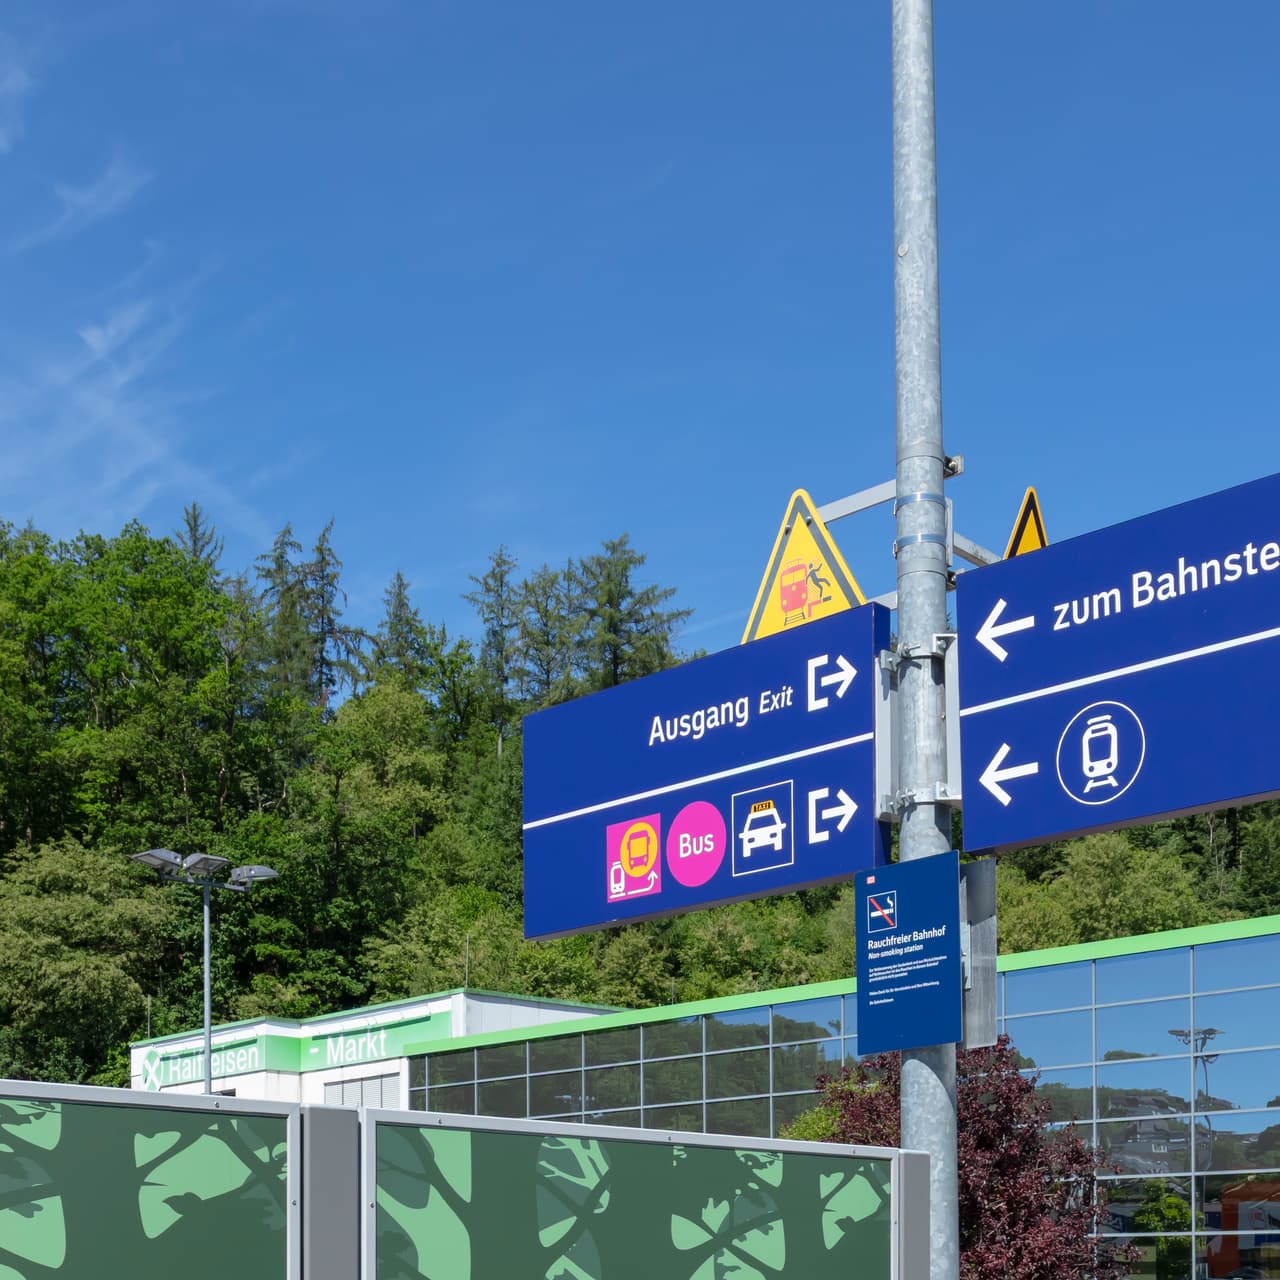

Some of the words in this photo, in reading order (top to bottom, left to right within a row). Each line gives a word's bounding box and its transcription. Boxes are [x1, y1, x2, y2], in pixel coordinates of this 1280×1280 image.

[1052, 586, 1122, 631] zum
[648, 696, 749, 746] Ausgang
[759, 685, 794, 714] Exit
[679, 833, 715, 858] Bus
[867, 933, 912, 950] Rauchfreier
[912, 924, 947, 942] Bahnhof
[867, 946, 904, 960] Non-smoking
[904, 943, 924, 954] station
[168, 1046, 259, 1082] Raifeisen
[327, 1028, 387, 1066] Markt
